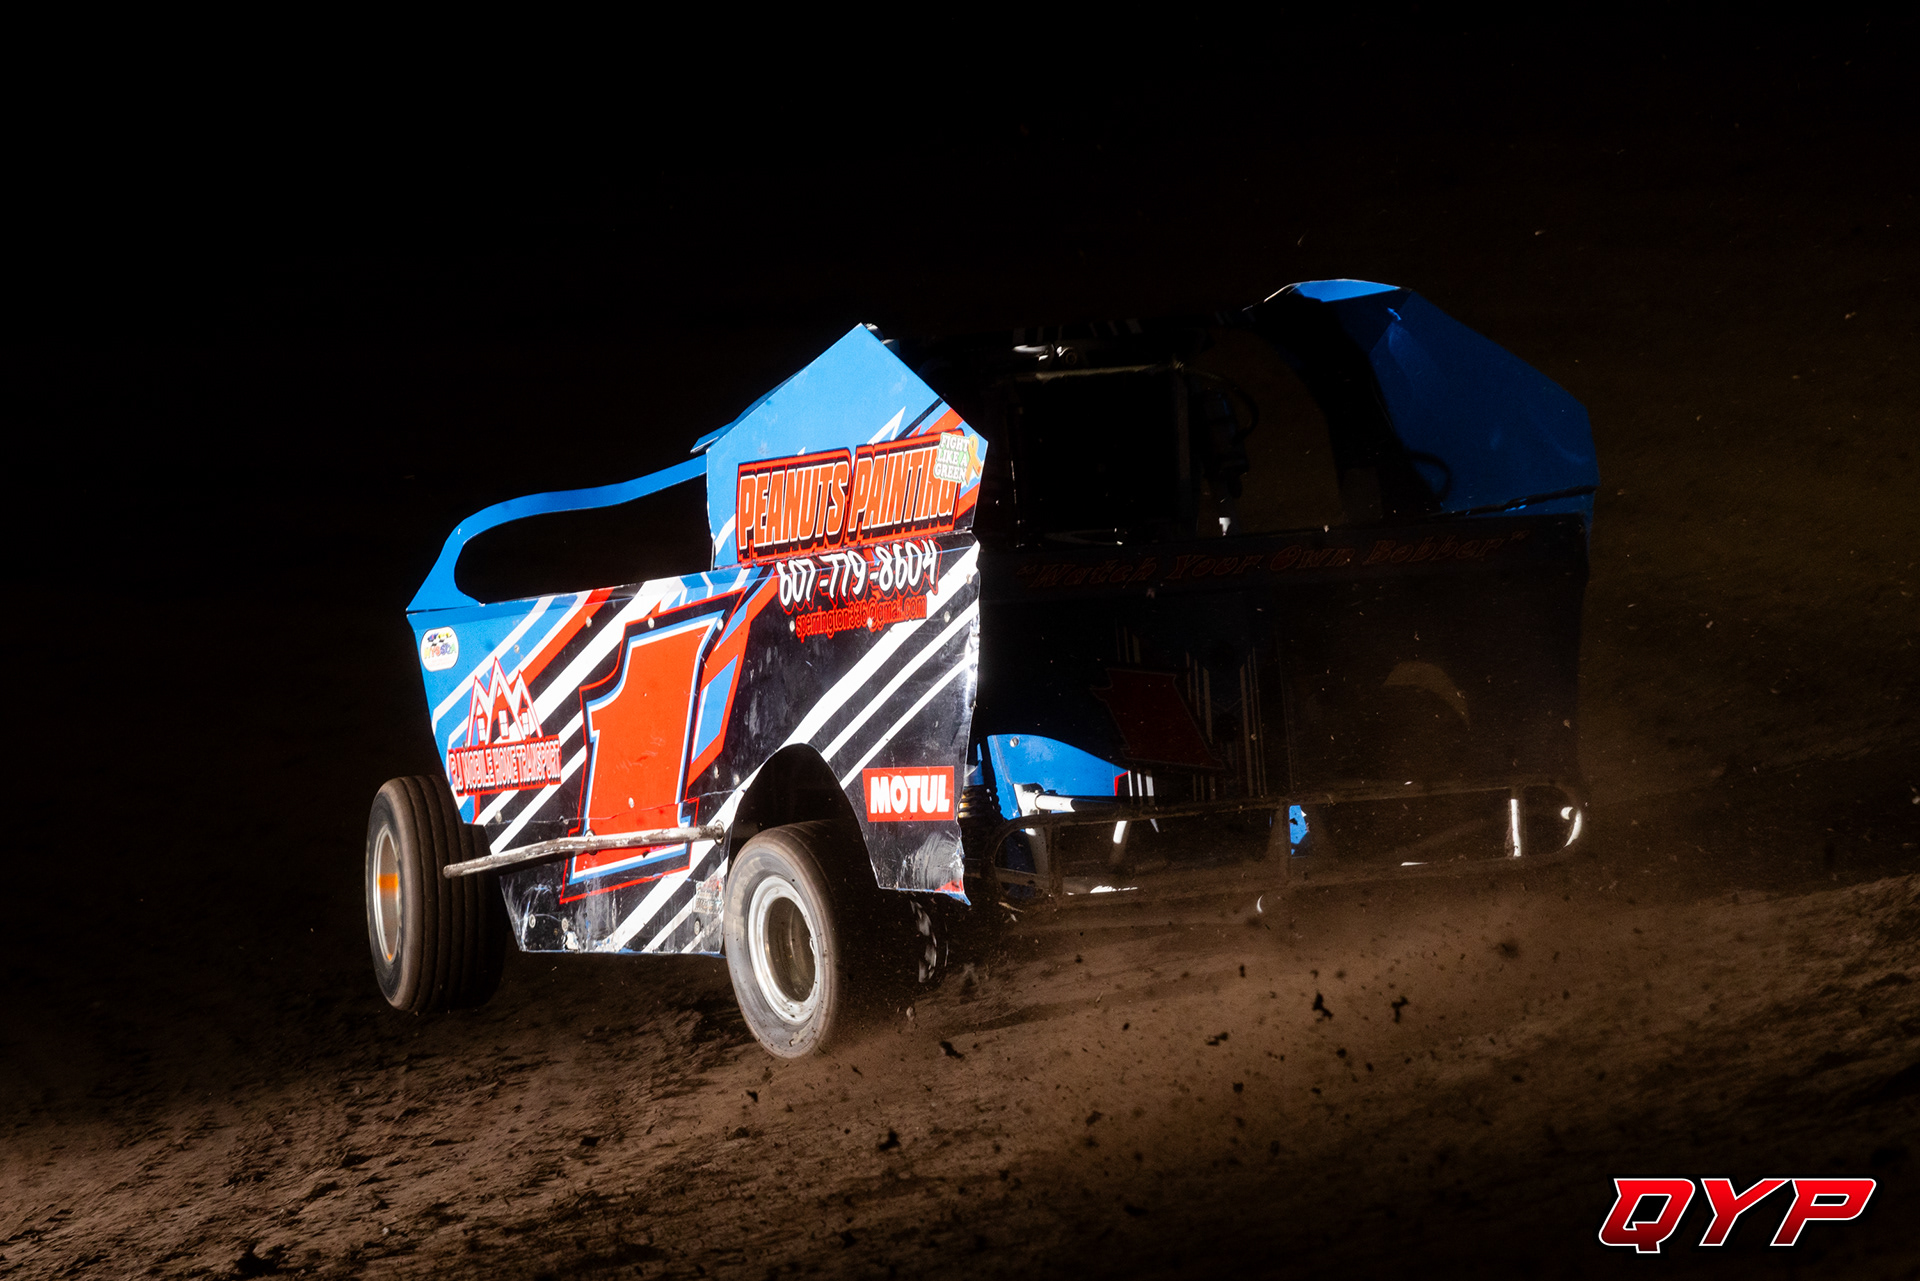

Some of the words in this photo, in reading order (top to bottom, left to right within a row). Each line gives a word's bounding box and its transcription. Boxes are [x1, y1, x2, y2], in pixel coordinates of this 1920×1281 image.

[937, 449, 959, 465] LIKE
[960, 453, 968, 467] A
[940, 434, 970, 452] FIGHT
[934, 463, 968, 482] GREEN
[738, 460, 850, 551] PEANUTS
[777, 539, 937, 607] 607-779-8604
[1269, 544, 1356, 572] Own
[461, 749, 495, 789] MOBILE
[492, 746, 519, 786] HOME
[516, 740, 561, 783] TRANSPORT
[571, 610, 725, 885] 1
[870, 774, 950, 814] MOTUL
